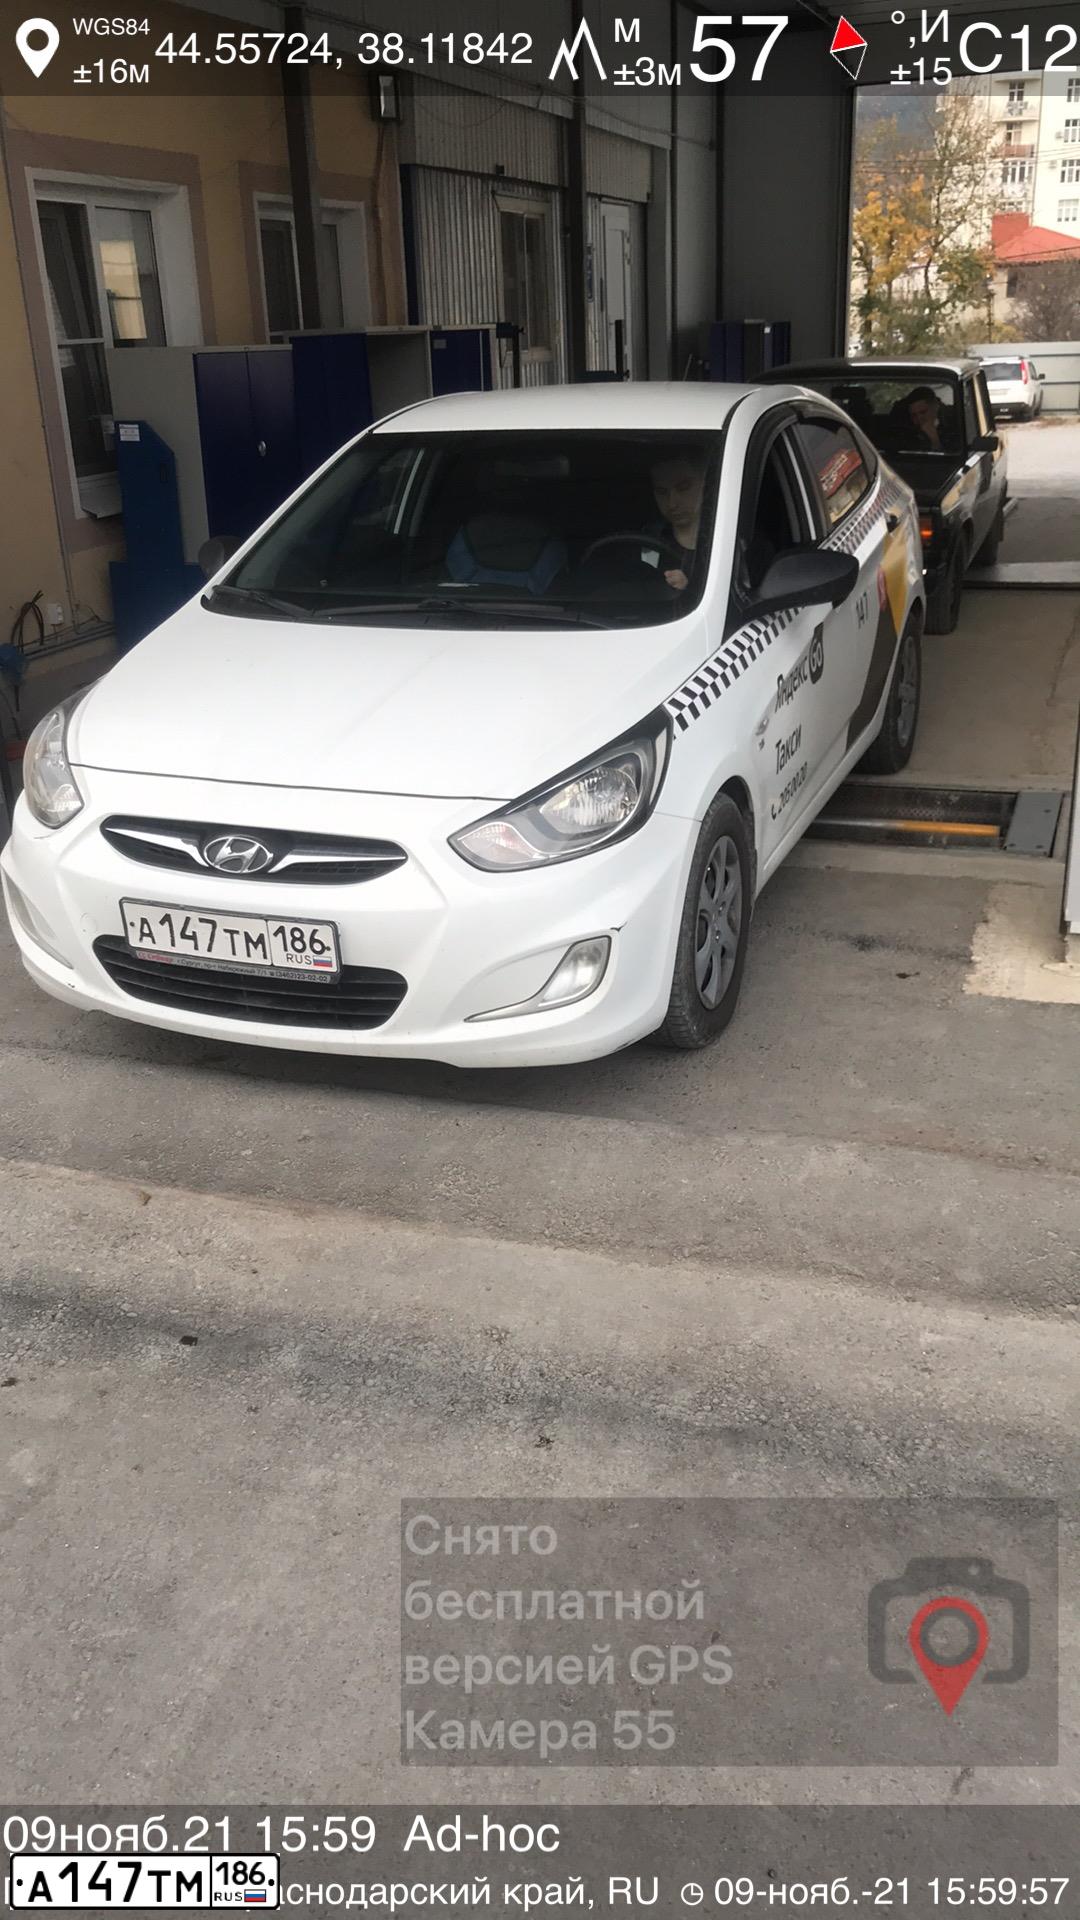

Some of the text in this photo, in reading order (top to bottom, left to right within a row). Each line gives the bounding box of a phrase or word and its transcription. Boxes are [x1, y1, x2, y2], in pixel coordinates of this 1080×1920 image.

[775, 724, 802, 775] Такси
[139, 912, 327, 961] А147ТМ 186
[285, 952, 313, 966] RUS
